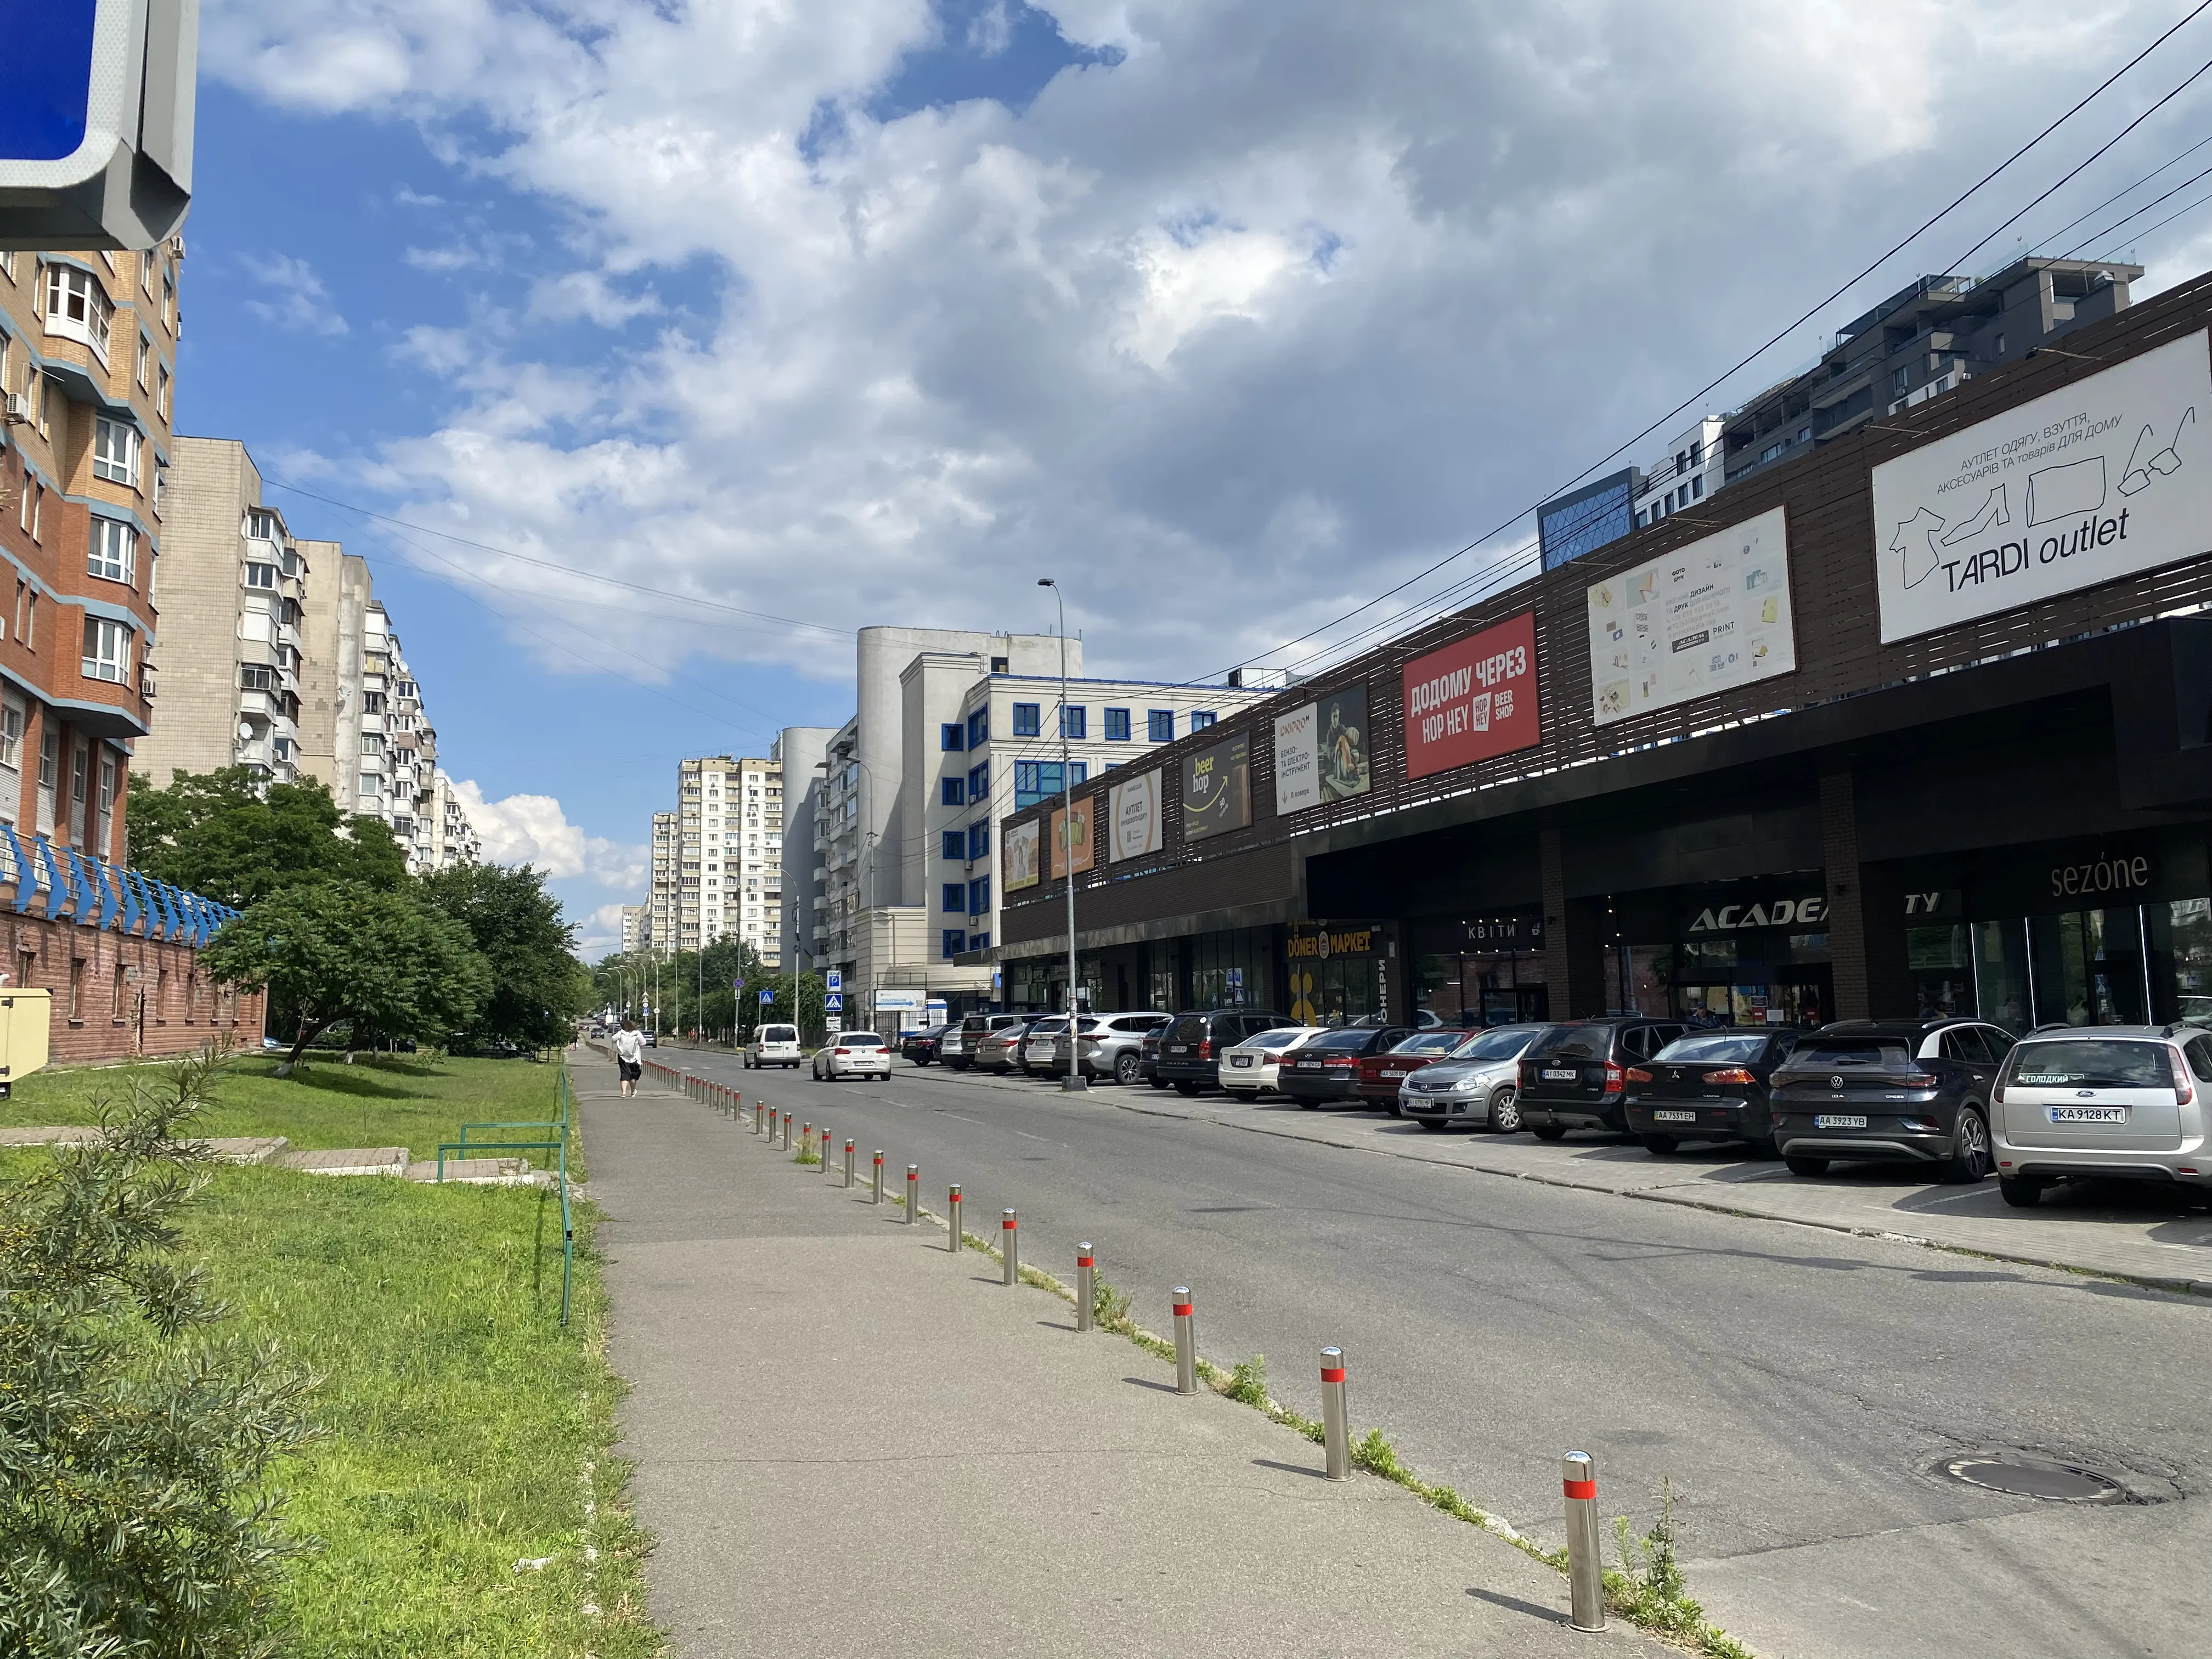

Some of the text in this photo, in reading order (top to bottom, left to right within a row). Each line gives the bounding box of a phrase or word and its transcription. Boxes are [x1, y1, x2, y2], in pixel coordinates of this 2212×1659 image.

[1961, 412, 2090, 471] АУТЛЕТ ОДЯГУ, ВЗУТТЯ,
[1937, 413, 2124, 495] АКСЕСУАРІВ ТА товарів ДЛЯ ДОМУ
[1941, 507, 2130, 592] TARDI outlet
[1672, 567, 1685, 576] ФОТО
[1673, 574, 1684, 583] ДРУК
[1674, 601, 1689, 613] ДРУК
[1702, 586, 1730, 602] КОЖНОГО
[1690, 583, 1714, 599] ДИЗАЙН
[1713, 620, 1735, 635] PRINT
[1410, 646, 1527, 718] ДОДОМУ ЧЕРЕЗ
[1475, 697, 1488, 713] HOP
[1494, 689, 1513, 707] BEER
[1475, 711, 1488, 727] HEY
[1495, 704, 1514, 720] SHOP
[1422, 704, 1469, 744] HOP HEY
[1280, 746, 1297, 758] БЕНЗО-
[1280, 752, 1310, 769] ТА ЕЛЕКТРО-
[1194, 756, 1215, 776] beer
[1281, 761, 1311, 778] ІНСТРУМЕНТ
[1192, 774, 1209, 794] hop
[1295, 788, 1310, 798] поверх
[1125, 800, 1143, 816] АУТЛЕТ
[2051, 851, 2148, 897] sezóne
[1689, 891, 1941, 932] ACADE TY
[1468, 924, 1515, 939] КВІТИ
[1288, 934, 1318, 957] DÖNER
[1330, 931, 1371, 953] МАРКЕТ
[1378, 959, 1389, 1025] ОНЕРИ
[2025, 1074, 2068, 1084] СОЛОДКИЙ
[1668, 1111, 1683, 1120] 7531
[1684, 1112, 1694, 1120] EH
[1819, 1116, 1865, 1126] AA 3923 YB
[2058, 1109, 2120, 1120] KA 9128 KT
